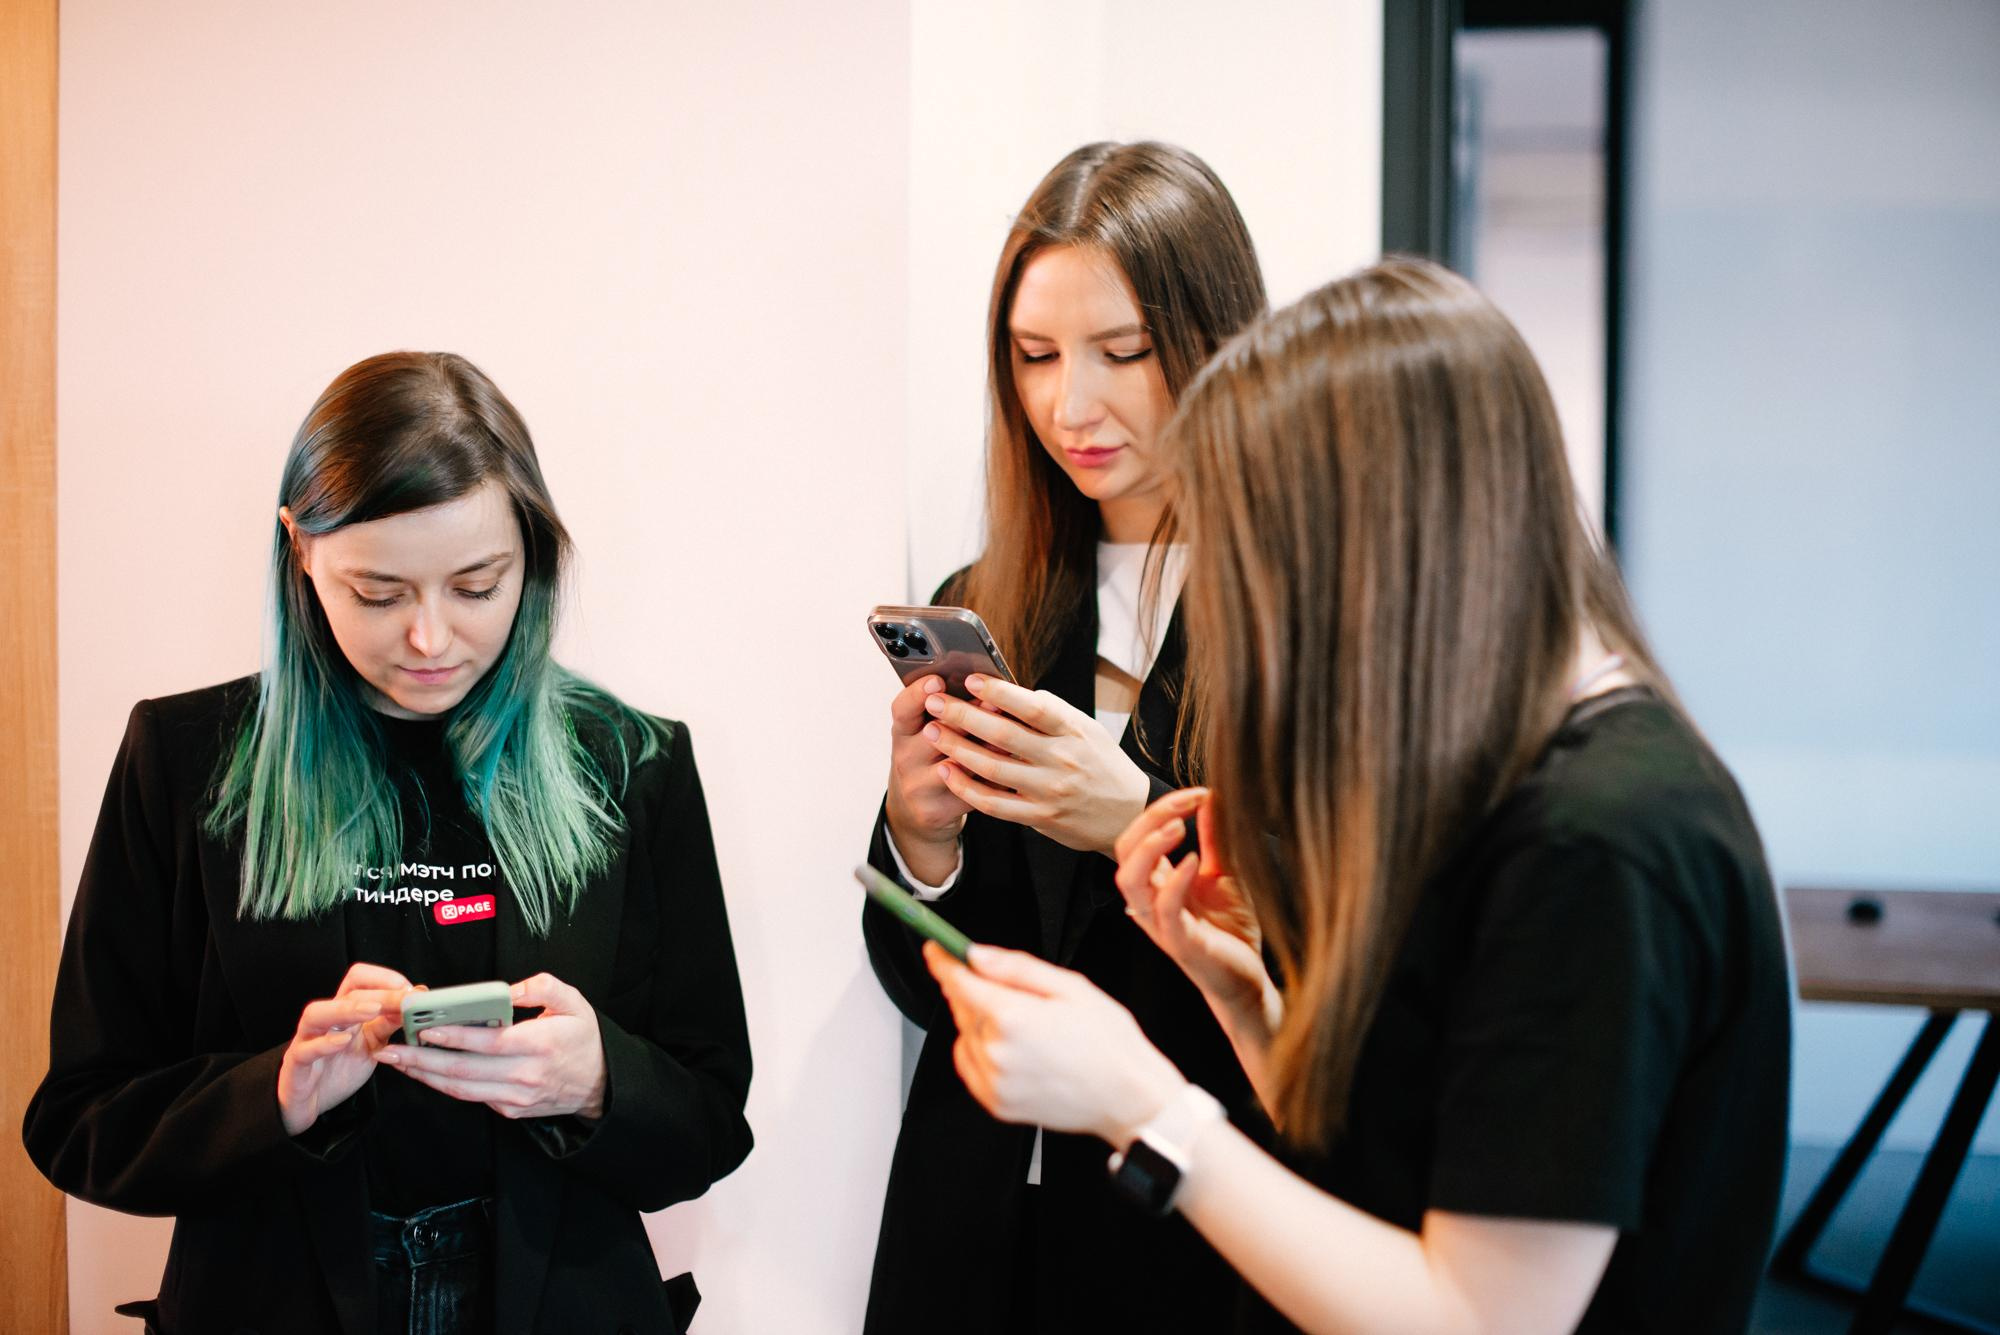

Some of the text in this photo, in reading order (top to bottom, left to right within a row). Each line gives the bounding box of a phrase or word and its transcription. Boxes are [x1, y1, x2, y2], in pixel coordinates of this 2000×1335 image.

[354, 862, 496, 880] лся мэтч по
[353, 886, 454, 906] тиндере
